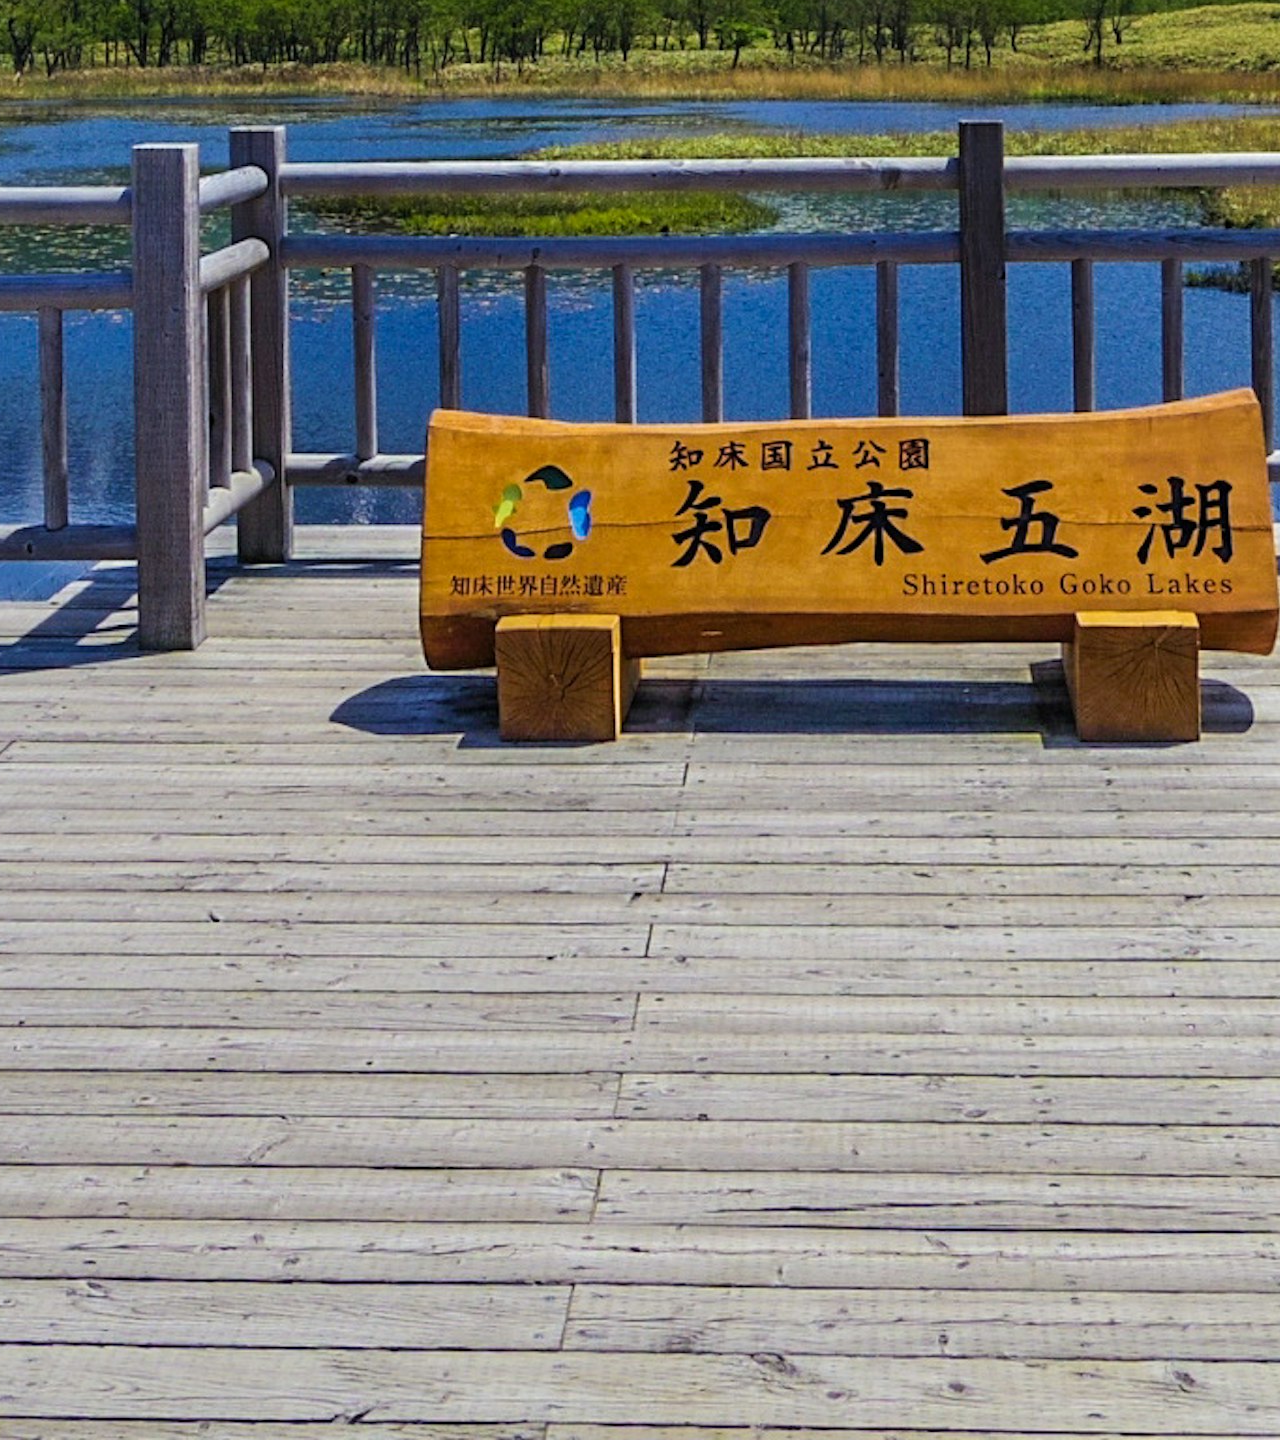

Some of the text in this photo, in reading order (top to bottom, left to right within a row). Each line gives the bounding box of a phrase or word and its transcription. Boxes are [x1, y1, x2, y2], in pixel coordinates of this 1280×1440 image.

[669, 438, 931, 472] 知床国立公園
[670, 476, 1234, 568] 知床五湖
[450, 574, 628, 597] 知床世界自然遺産
[902, 572, 1233, 596] Shiretoko Goko Lakes
